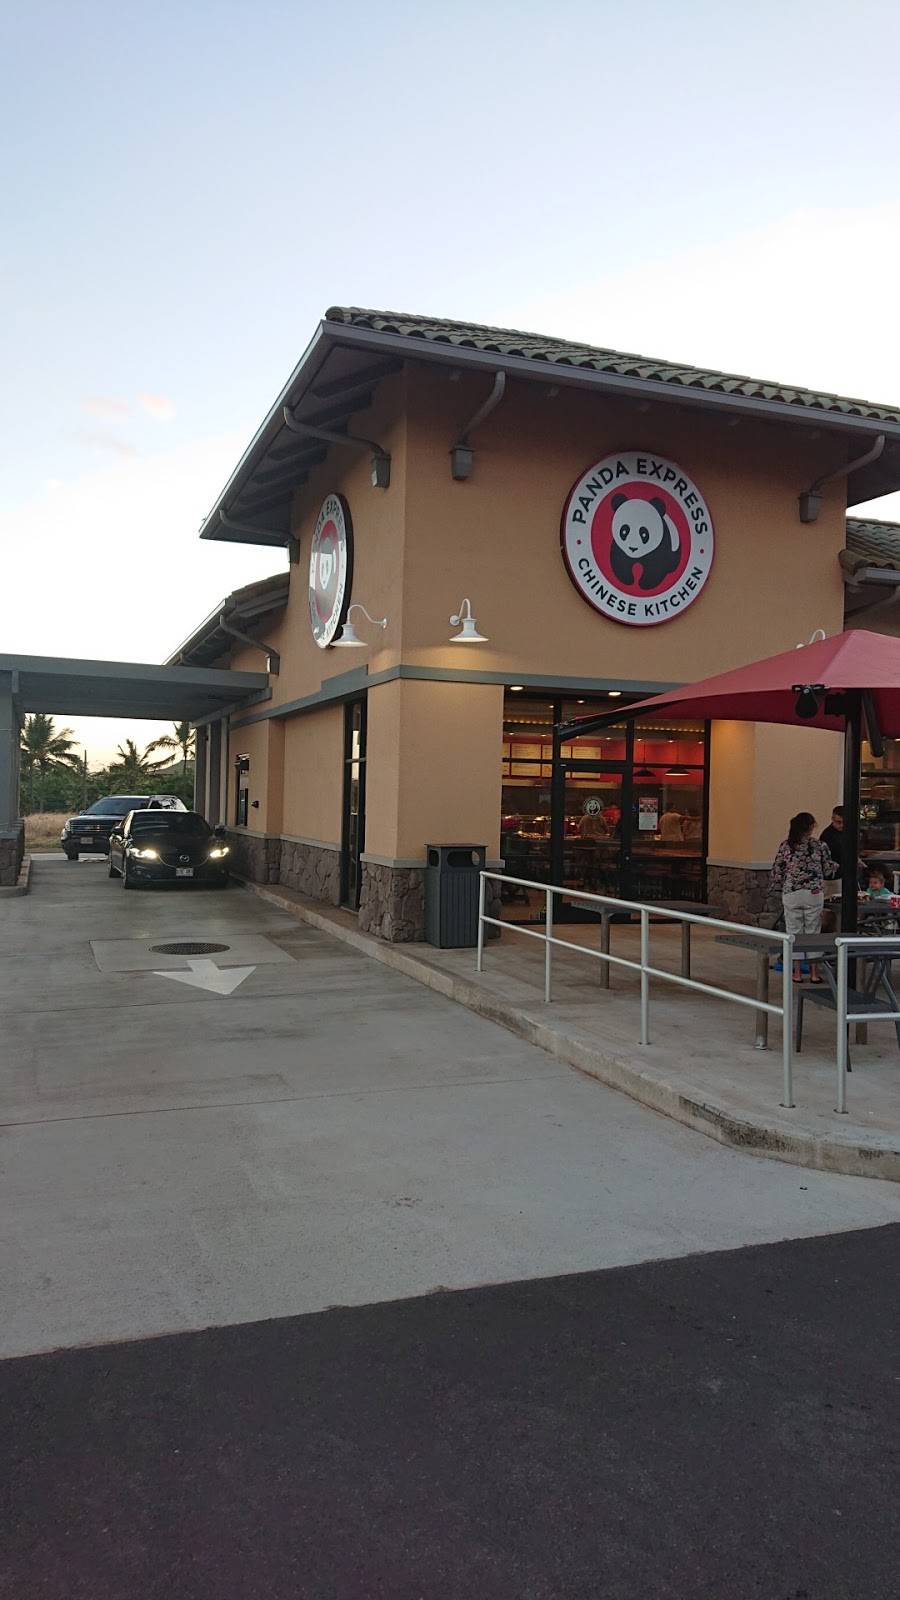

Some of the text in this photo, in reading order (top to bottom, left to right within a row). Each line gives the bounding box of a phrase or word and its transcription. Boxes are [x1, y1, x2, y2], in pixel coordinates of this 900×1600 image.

[326, 500, 345, 551] EXPRE
[572, 458, 708, 535] PANDA EXPRESS
[578, 558, 704, 616] CHINESE KITCHEN
